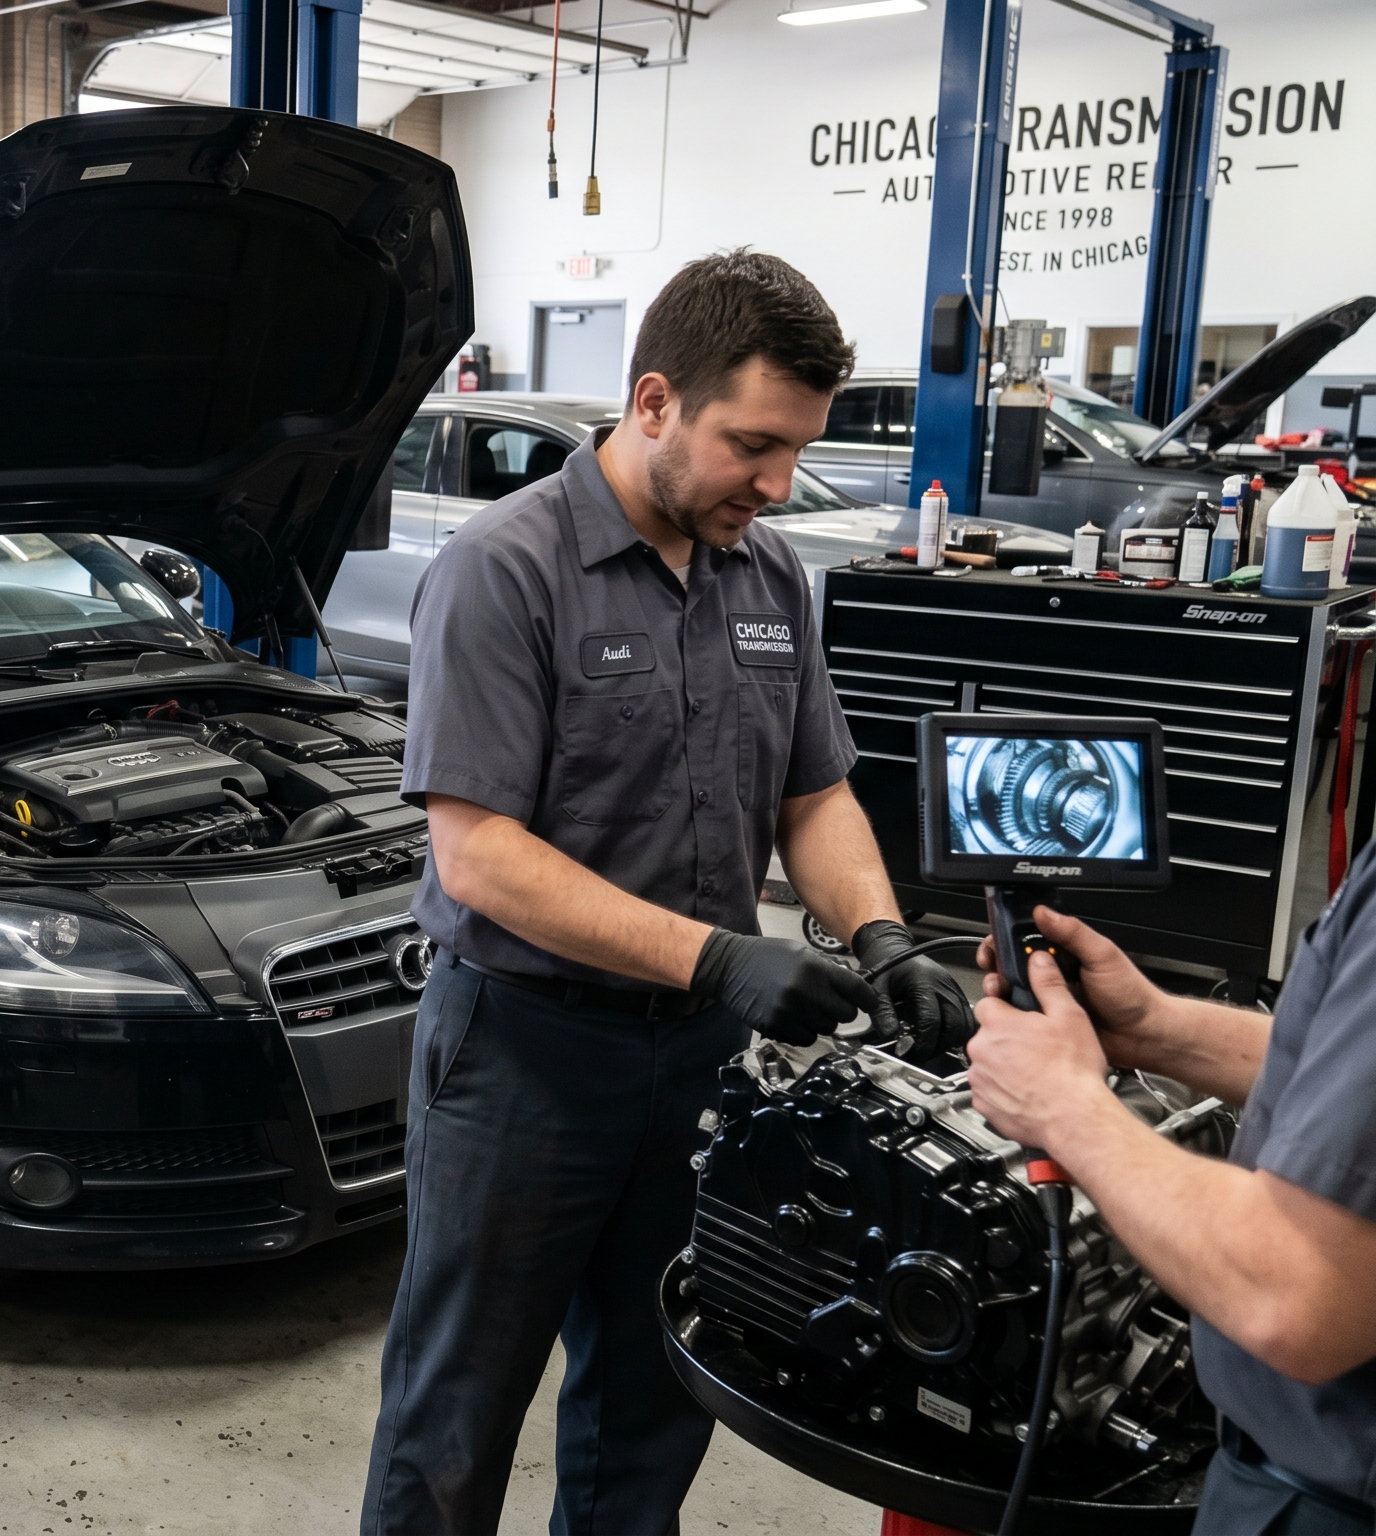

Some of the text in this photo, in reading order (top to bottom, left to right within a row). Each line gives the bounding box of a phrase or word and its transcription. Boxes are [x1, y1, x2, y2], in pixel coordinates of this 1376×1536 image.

[811, 116, 936, 166] CHICA
[1003, 207, 1113, 231] NCE 1998
[1043, 252, 1062, 272] IN
[1072, 235, 1148, 270] CHICAG
[1182, 604, 1268, 624] Snap-on
[735, 623, 791, 640] CHICAGO
[602, 644, 632, 661] Audi
[1012, 861, 1083, 878] Snap-on
